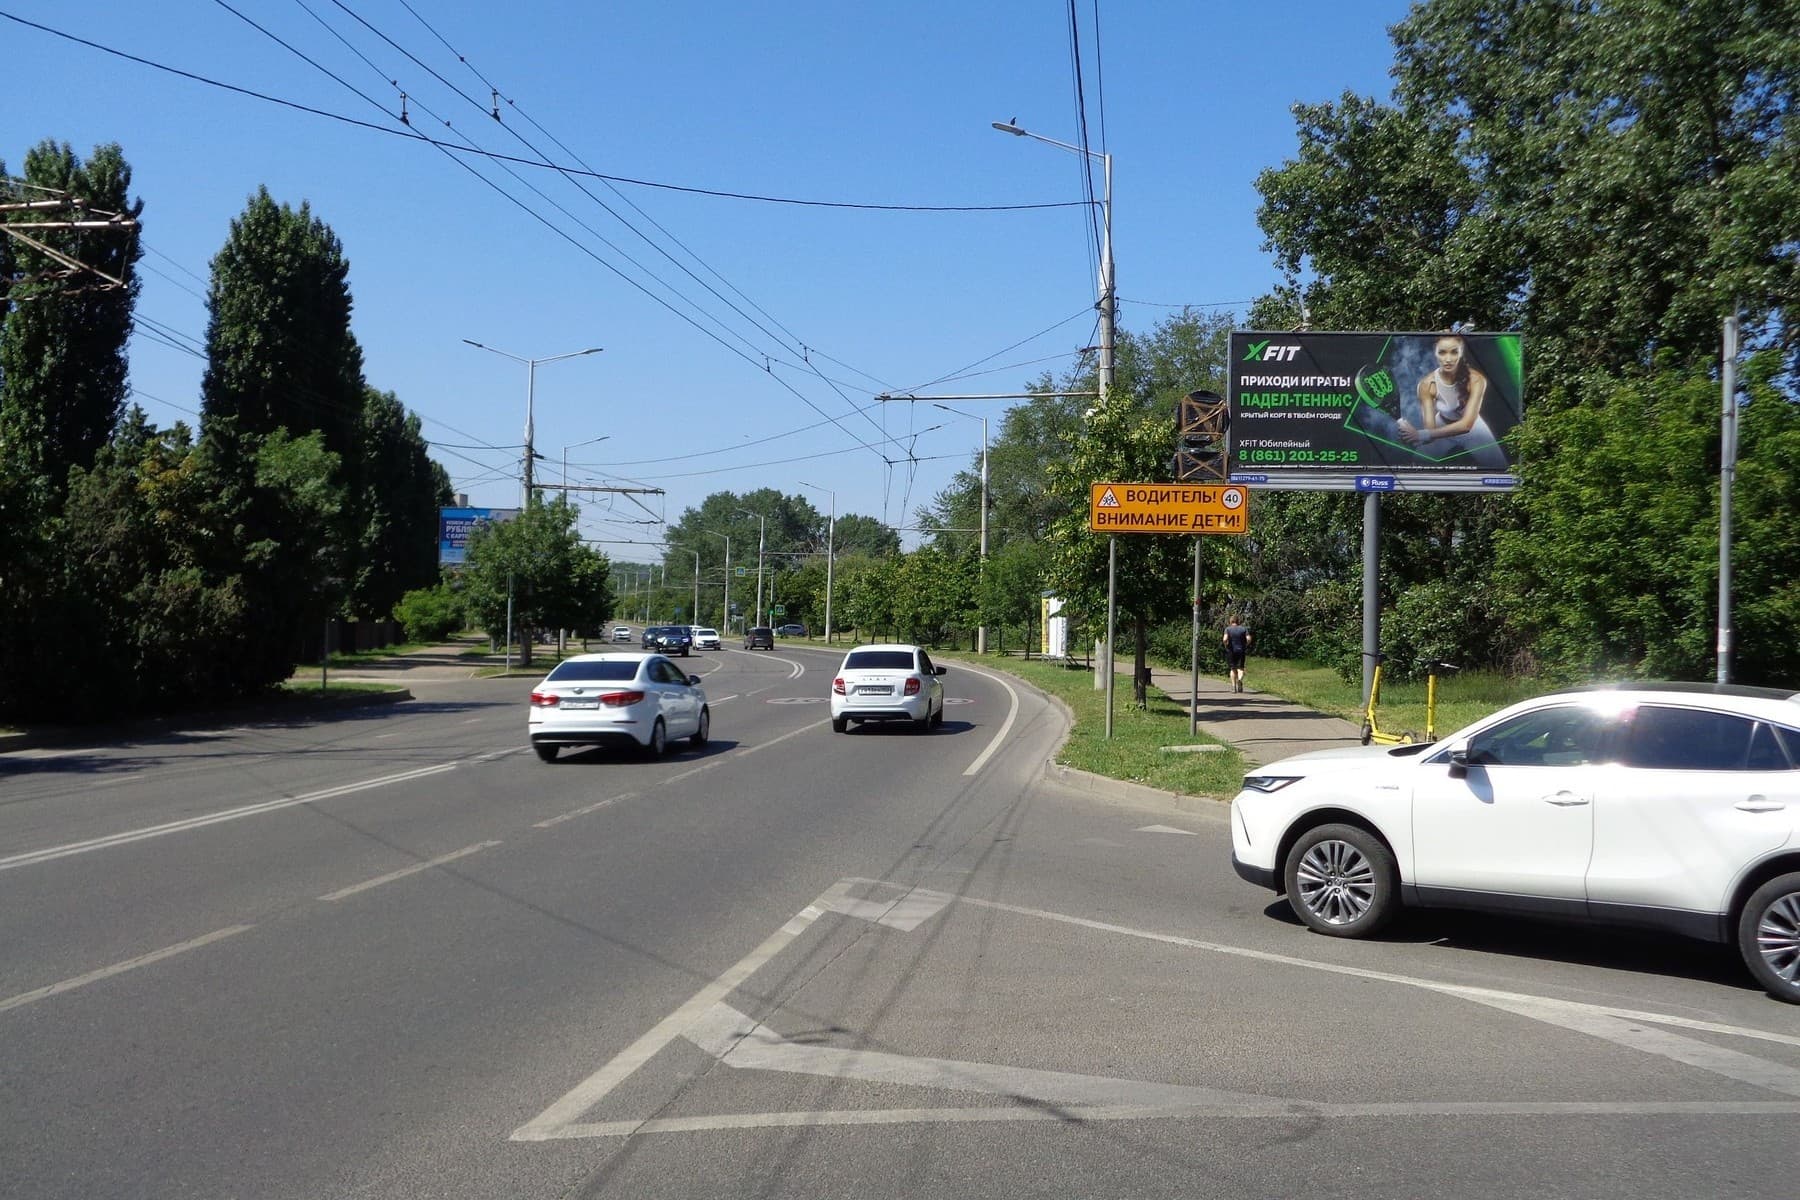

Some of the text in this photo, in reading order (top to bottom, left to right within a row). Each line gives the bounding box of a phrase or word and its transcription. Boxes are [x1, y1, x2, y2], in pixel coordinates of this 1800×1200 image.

[1242, 340, 1301, 361] XFIT
[1240, 375, 1351, 388] ПРИХОДИ ИГРАТЬ!
[1240, 393, 1352, 408] ПАДЕЛ-ТЕННИС
[1259, 440, 1310, 448] Юбилейный
[1239, 450, 1358, 462] 8 (861) 201-25-25
[1126, 489, 1217, 505] ВОДИТЕЛЬ!
[1225, 493, 1239, 504] 40
[1097, 512, 1240, 529] ВНИМАНИЕ ДЕТИ!
